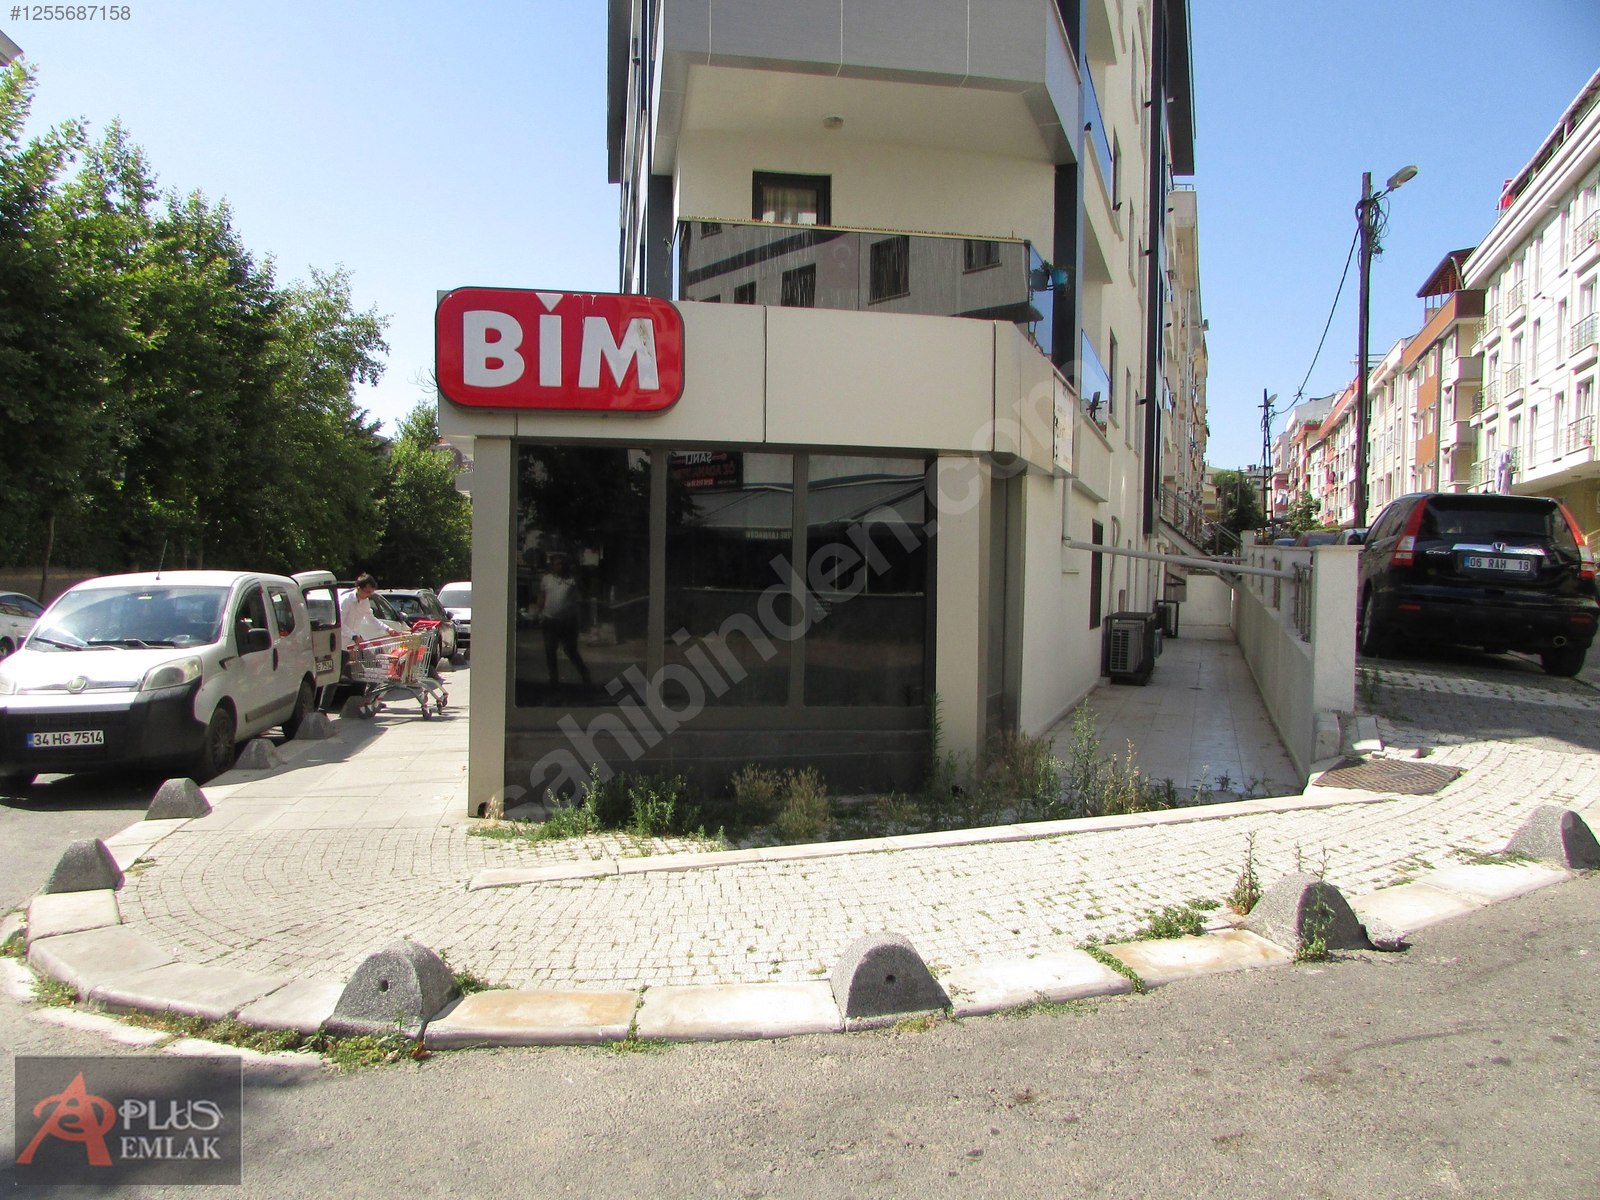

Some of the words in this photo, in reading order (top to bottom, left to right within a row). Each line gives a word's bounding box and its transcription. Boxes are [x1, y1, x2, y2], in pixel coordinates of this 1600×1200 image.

[463, 292, 660, 391] BİM
[34, 734, 49, 746] 34
[52, 733, 71, 745] HG
[74, 731, 103, 744] 7514
